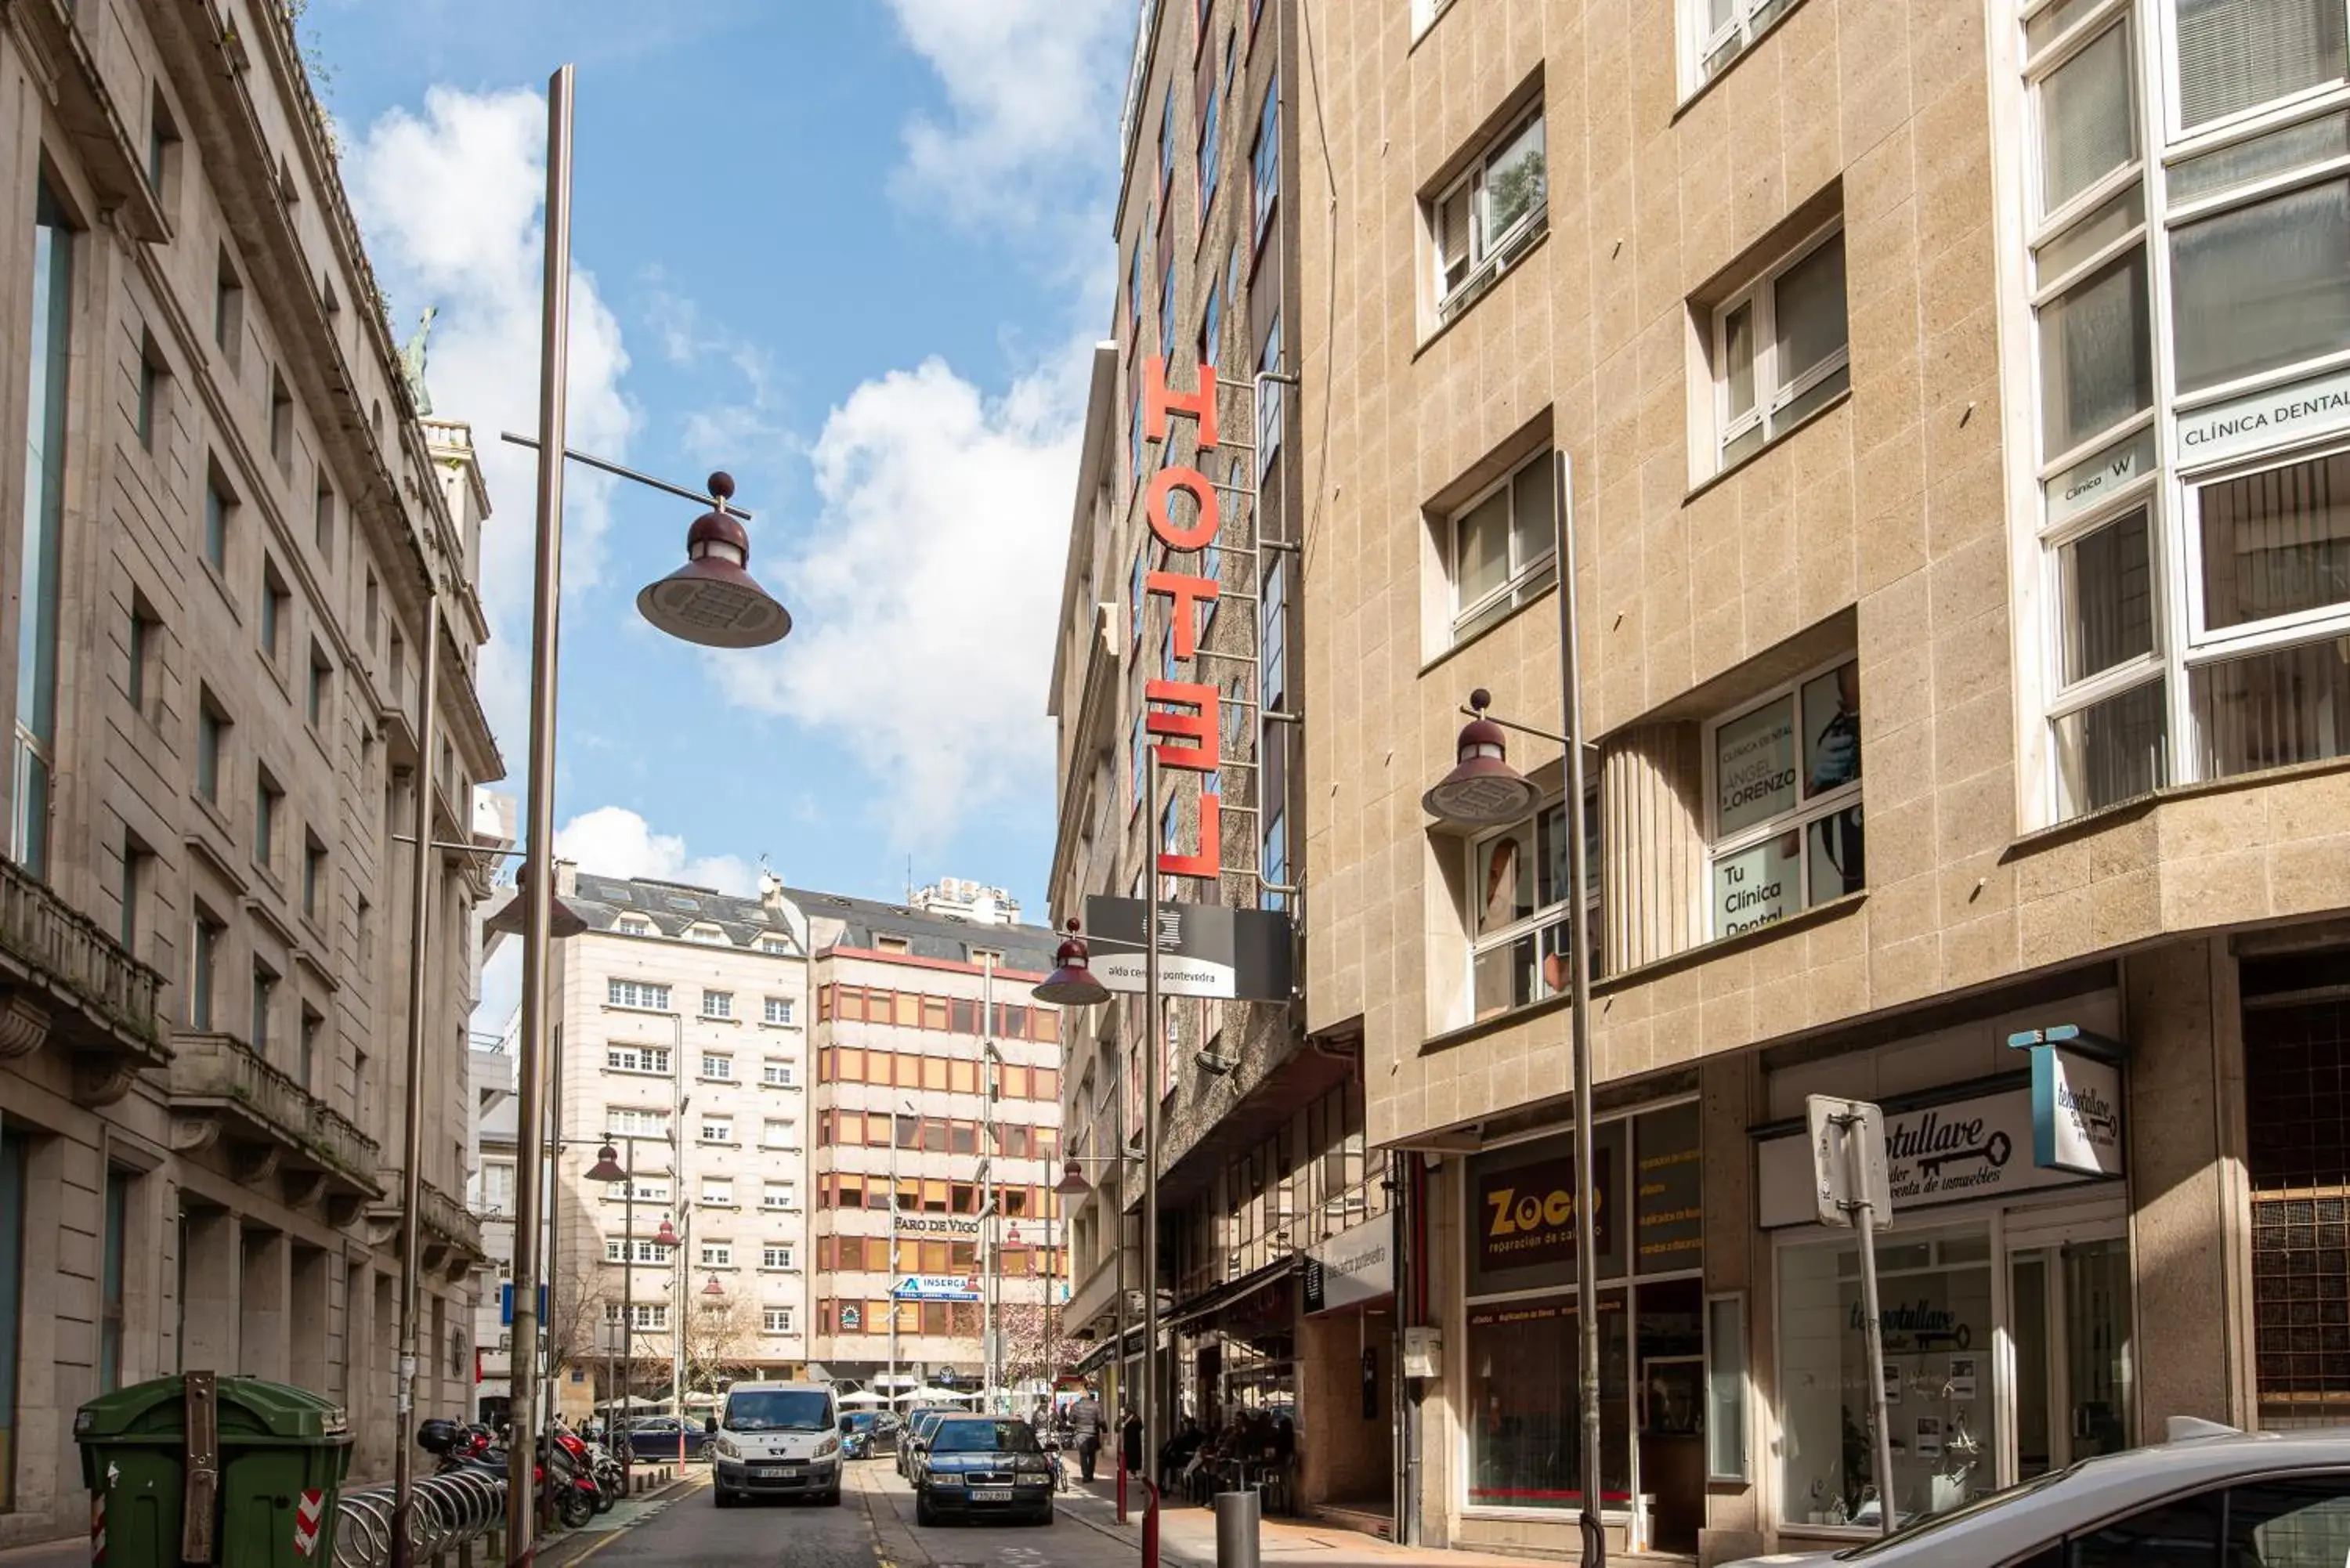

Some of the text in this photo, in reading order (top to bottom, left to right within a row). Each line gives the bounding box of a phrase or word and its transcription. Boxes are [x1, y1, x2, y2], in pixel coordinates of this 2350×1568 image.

[2185, 391, 2350, 446] CLÍNICA DENTAL
[2113, 456, 2131, 476] W
[1723, 768, 1796, 812] LORENZO
[1724, 865, 1744, 885] Tu
[1726, 882, 1781, 913] Clínica
[1163, 970, 1215, 983] pontevedra
[1923, 1176, 1939, 1194] de
[894, 1216, 979, 1234] FARO DE VIGO
